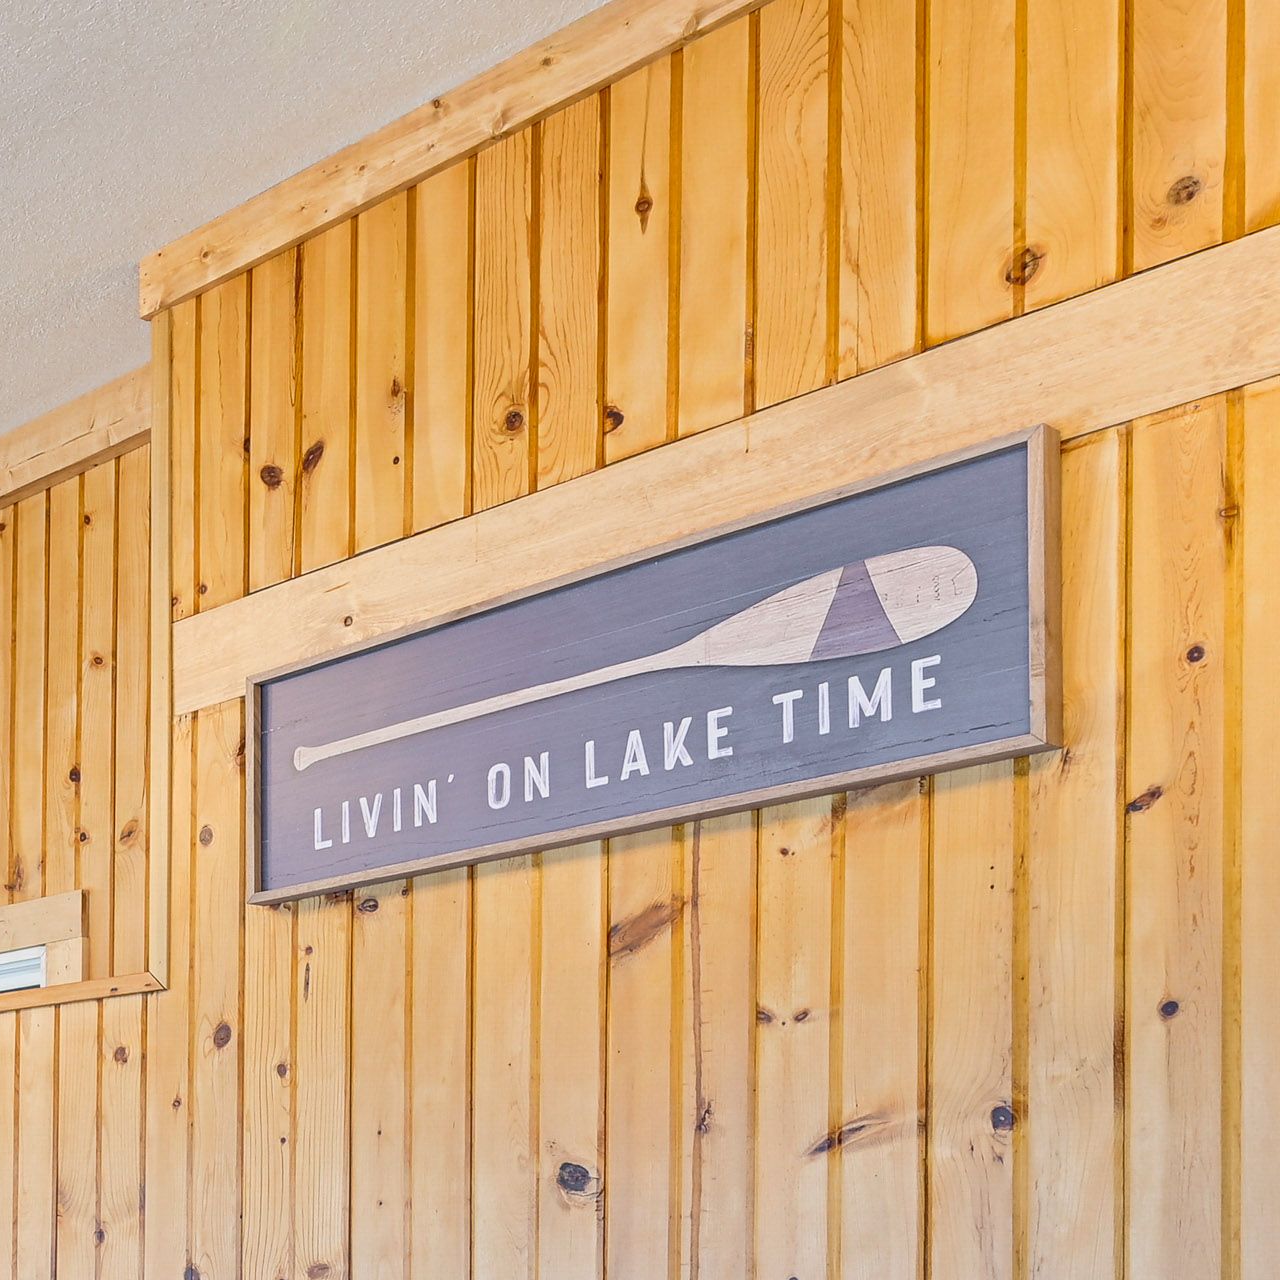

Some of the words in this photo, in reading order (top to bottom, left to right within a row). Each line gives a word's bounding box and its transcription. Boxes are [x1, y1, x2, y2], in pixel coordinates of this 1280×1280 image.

[313, 773, 455, 851] LIVIN'
[487, 751, 551, 810] ON
[584, 705, 734, 789] LAKE
[771, 653, 943, 744] TIME
